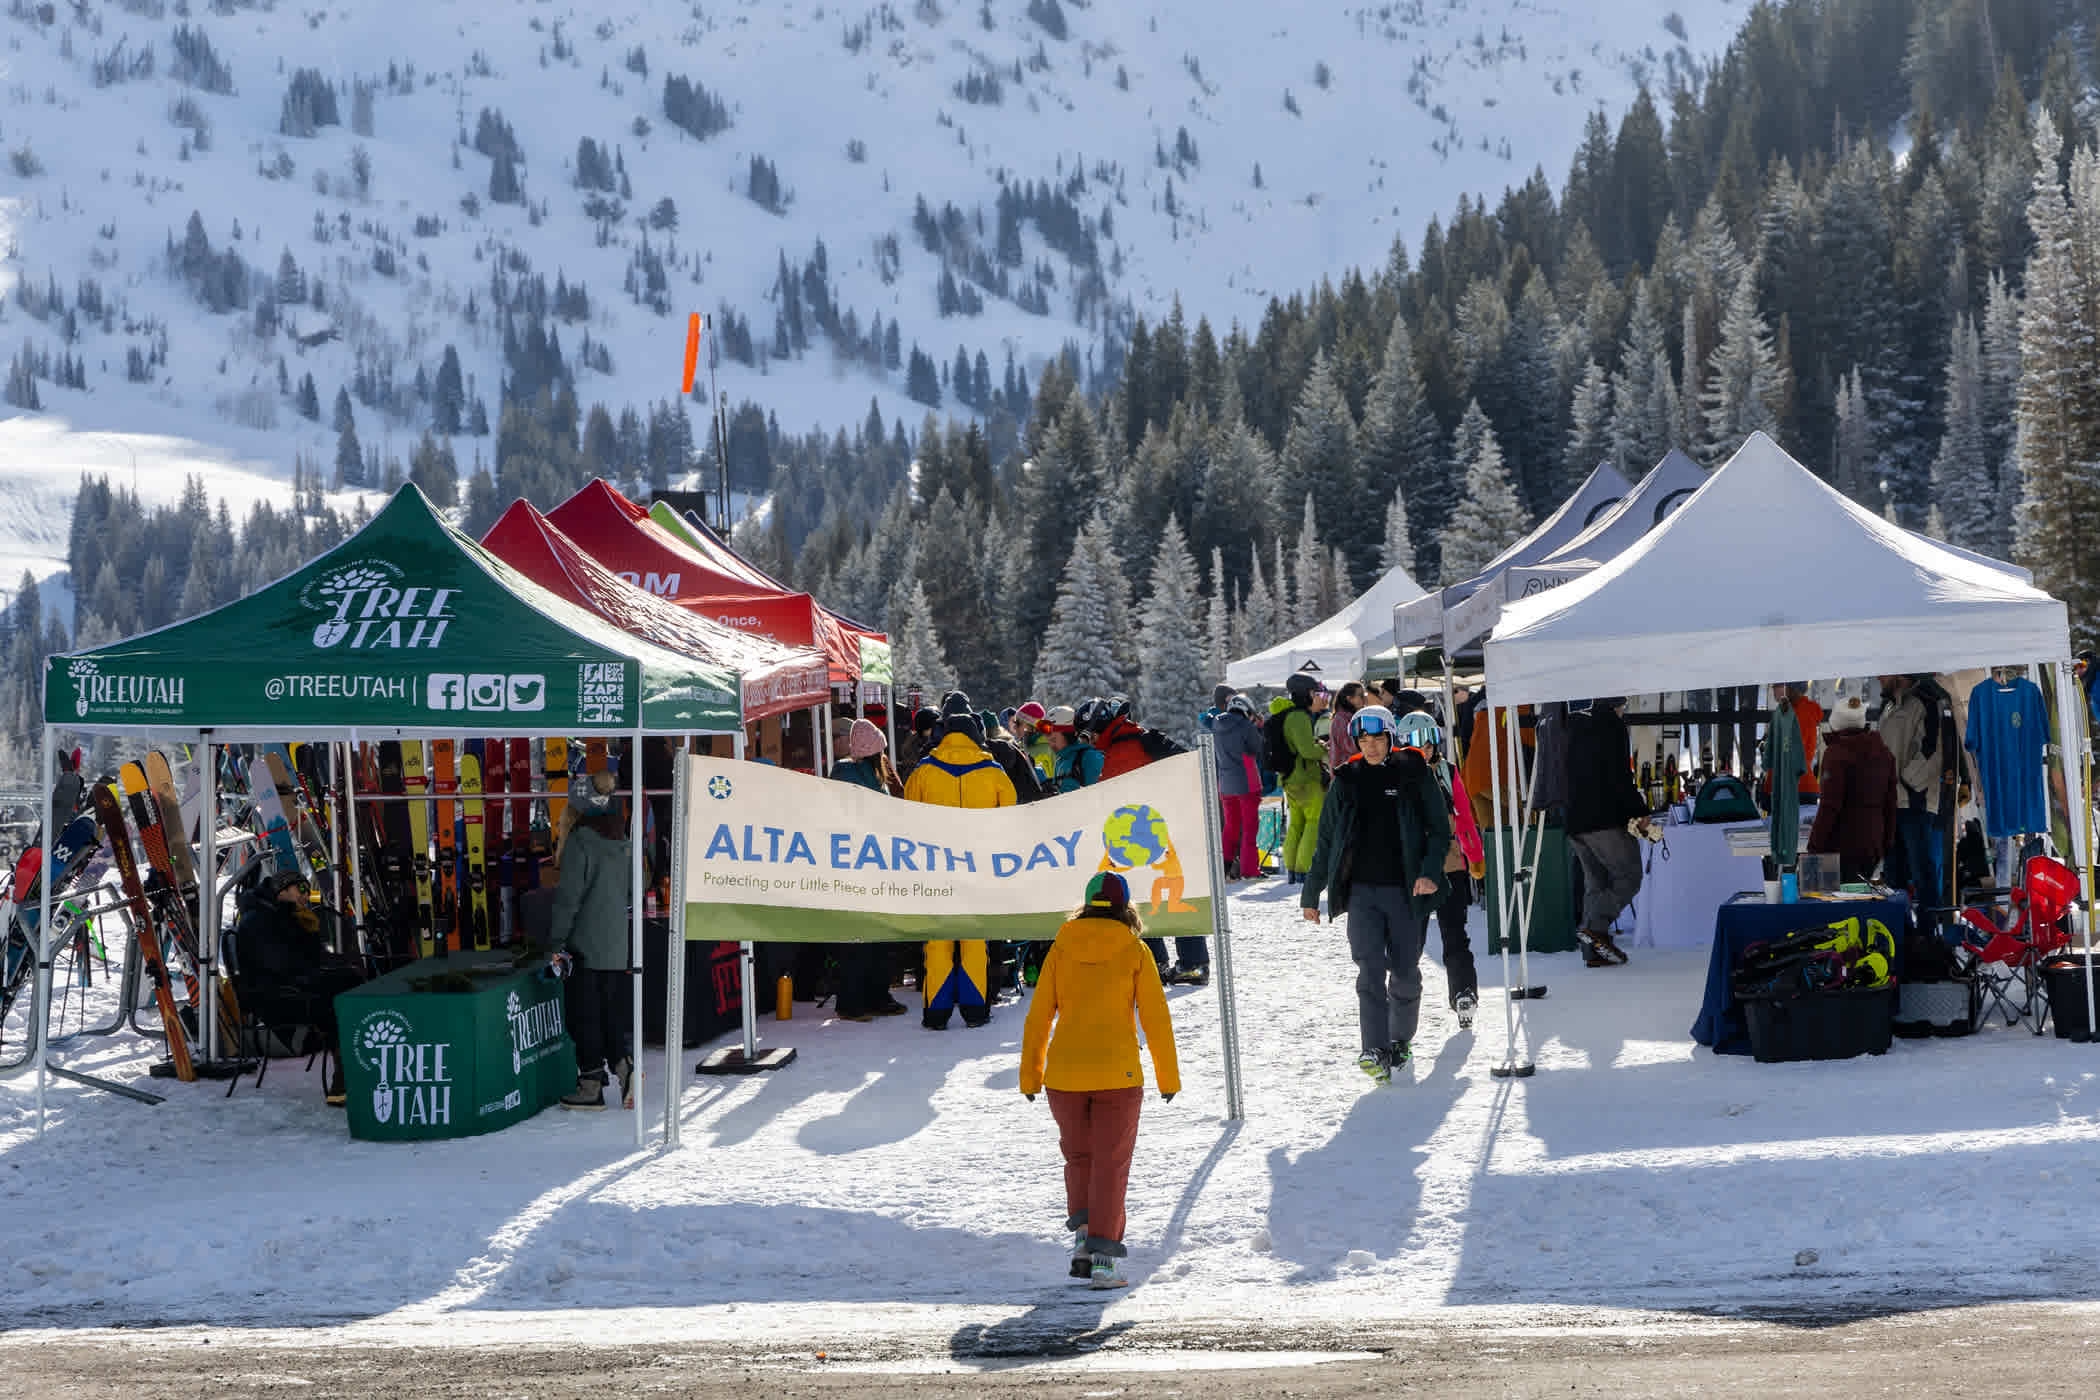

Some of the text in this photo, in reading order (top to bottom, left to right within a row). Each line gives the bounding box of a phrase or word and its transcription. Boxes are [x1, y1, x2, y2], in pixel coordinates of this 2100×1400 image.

[336, 586, 463, 618] TREE
[718, 615, 761, 627] Once,
[76, 674, 184, 705] TREEUTAH
[264, 675, 404, 700] @TREEUTAH
[583, 684, 617, 695] ZAP
[704, 824, 1083, 878] ALTA EARTH DAY
[703, 872, 954, 897] Protecting our Little Piece of the Planet
[375, 1043, 453, 1082] TREE
